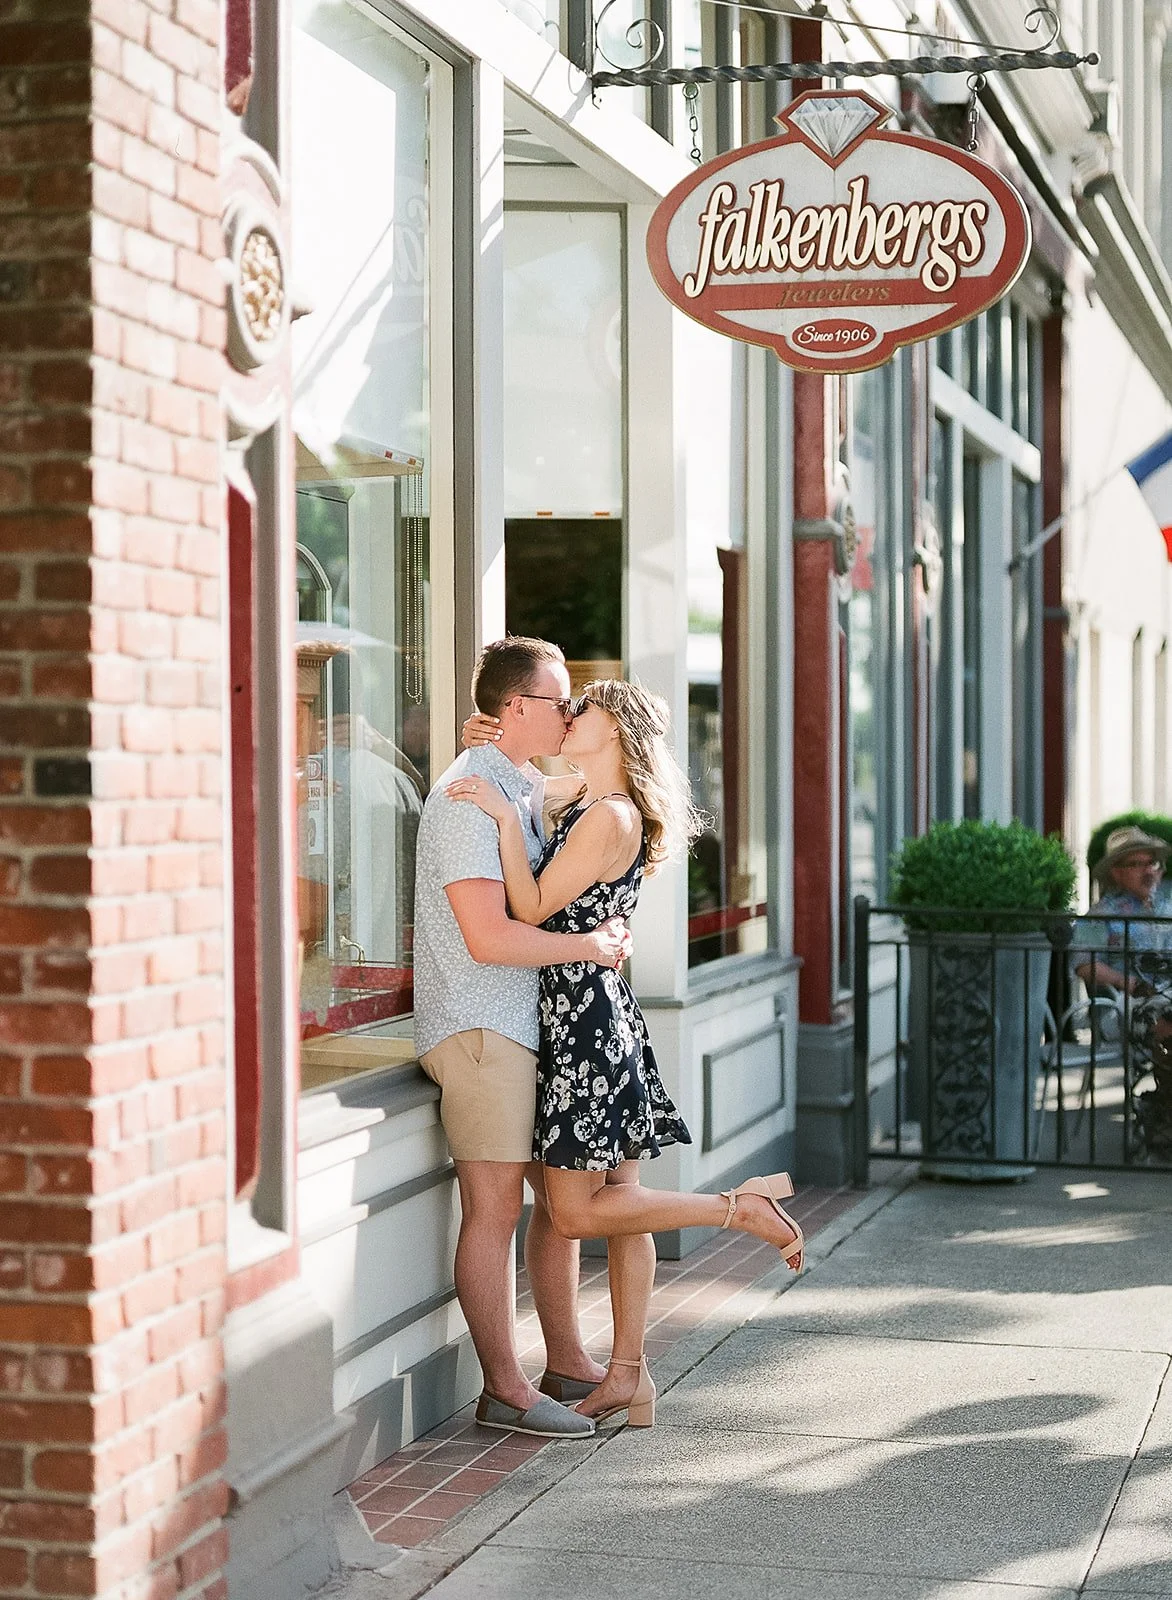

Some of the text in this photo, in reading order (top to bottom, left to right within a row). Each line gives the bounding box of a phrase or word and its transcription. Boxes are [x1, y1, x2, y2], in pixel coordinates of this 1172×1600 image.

[683, 175, 988, 298] falkenbergs
[776, 283, 891, 307] jewelers
[797, 325, 871, 345] Since 1906
